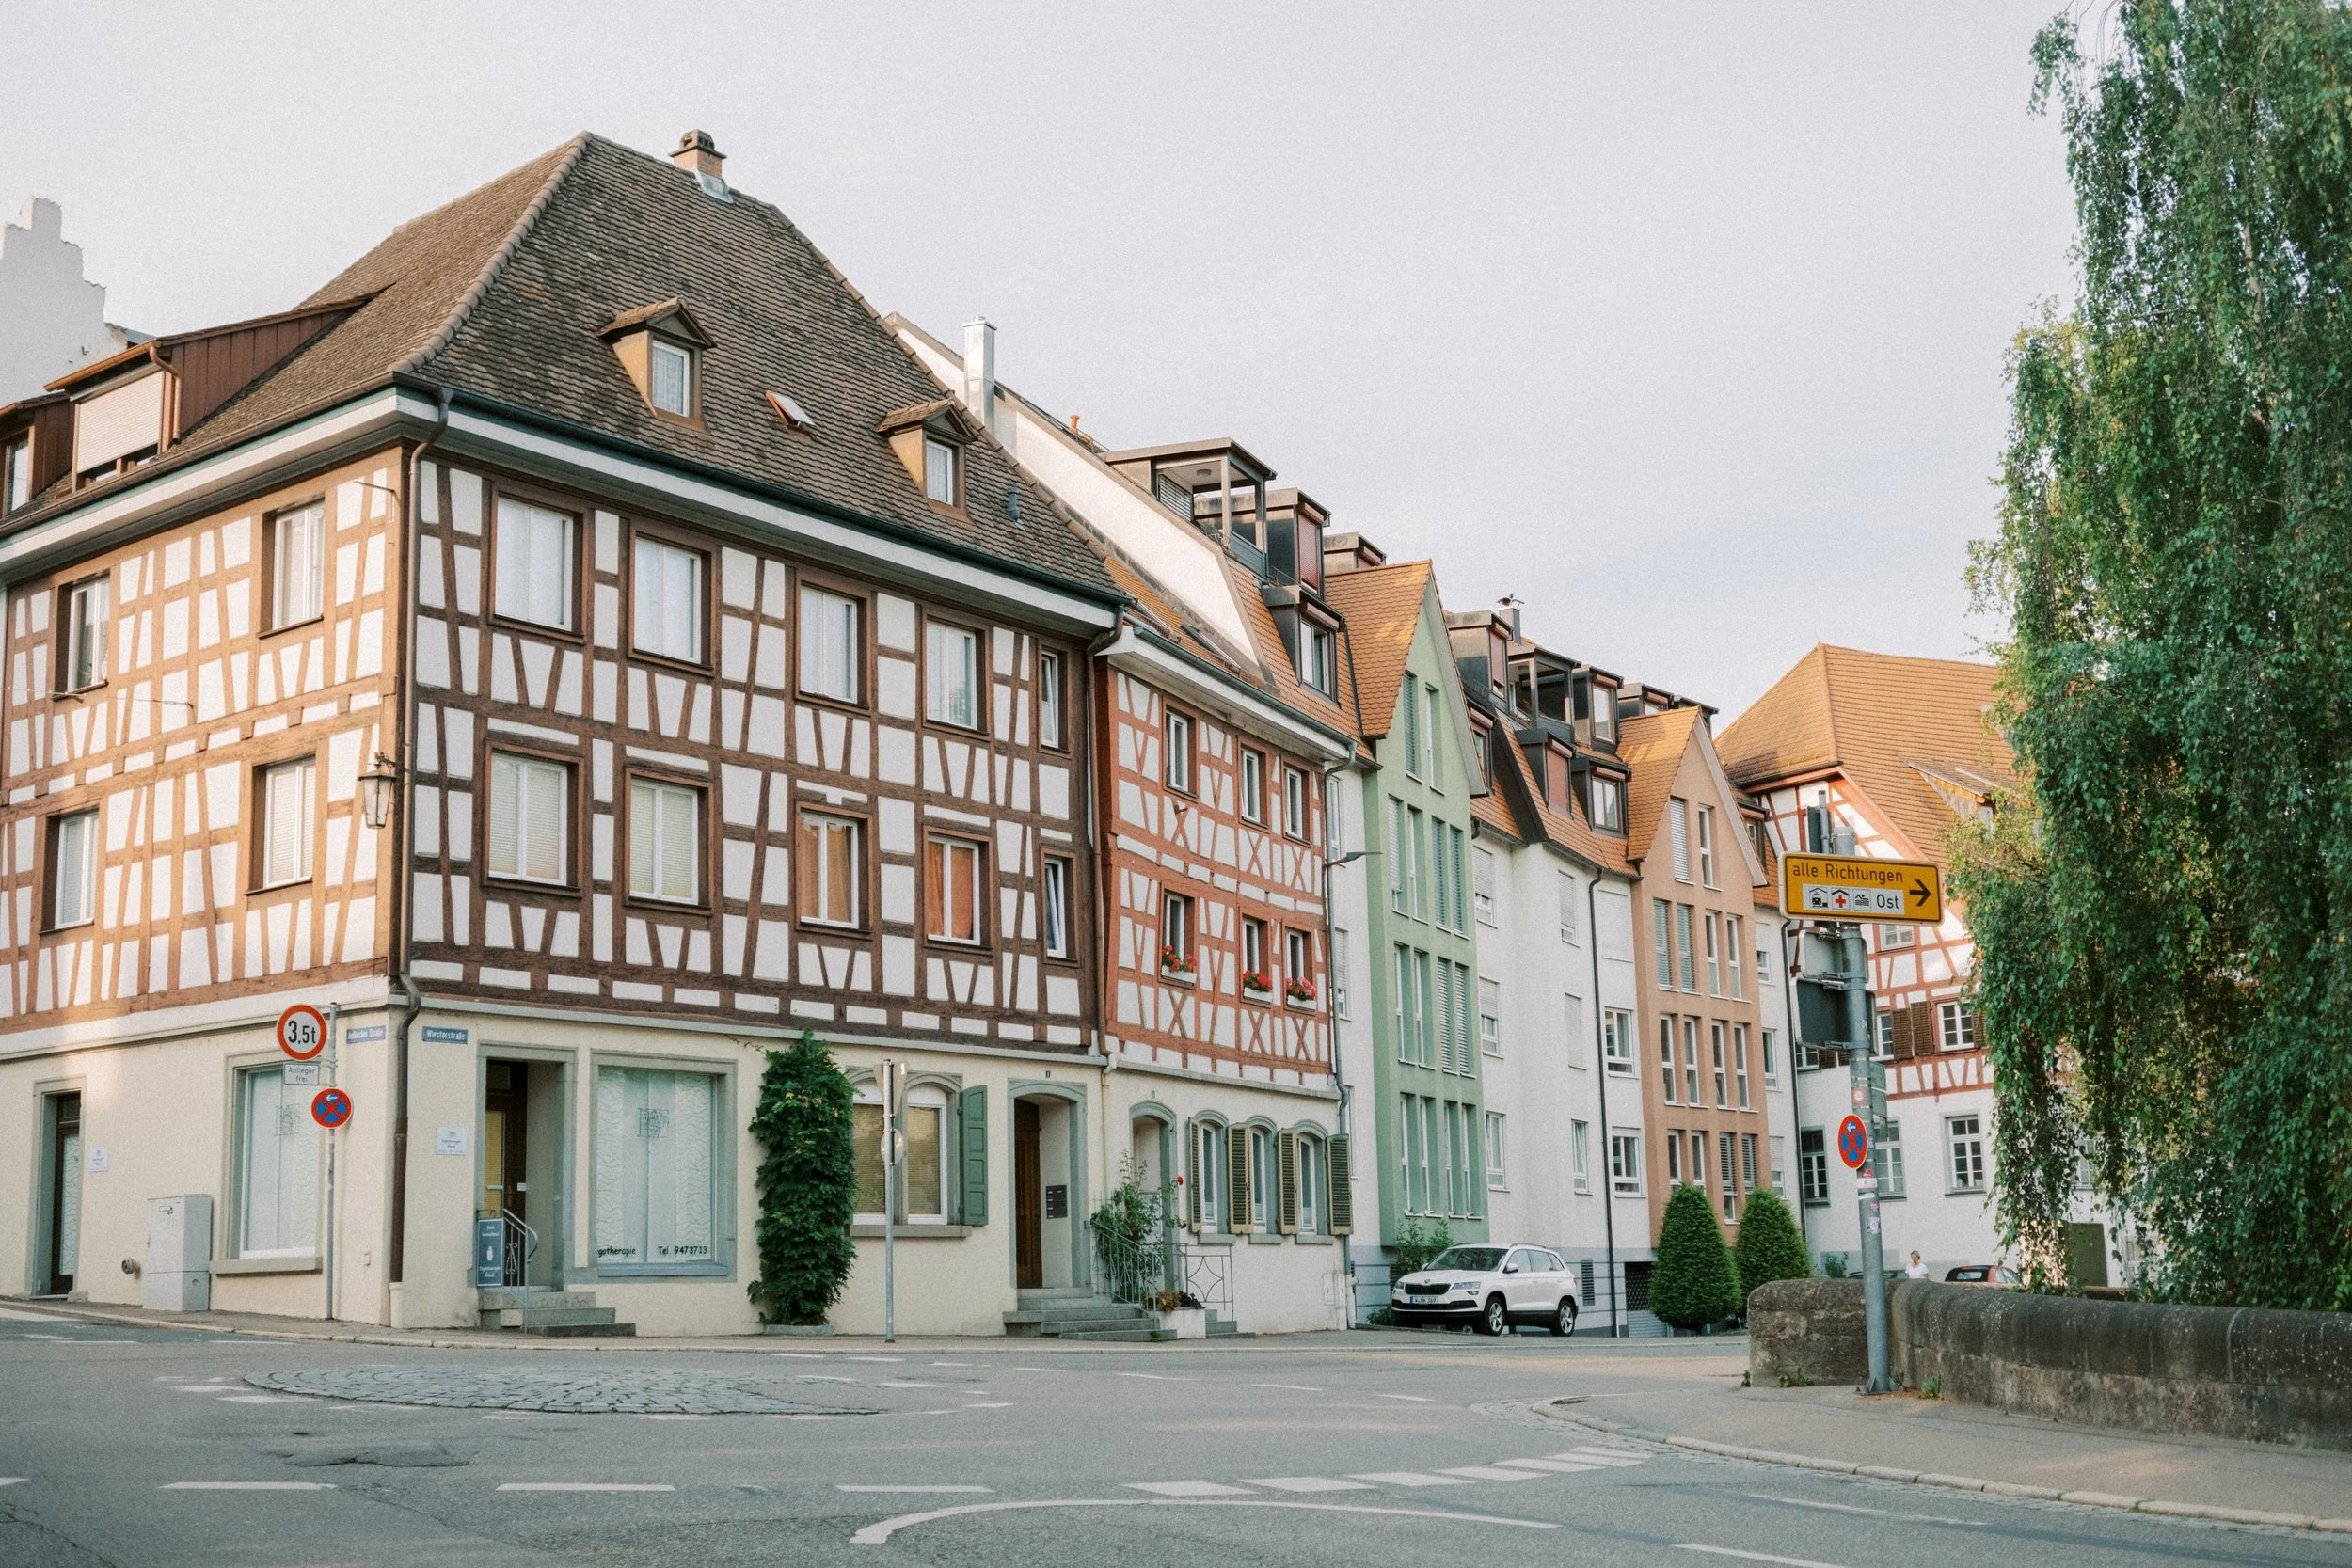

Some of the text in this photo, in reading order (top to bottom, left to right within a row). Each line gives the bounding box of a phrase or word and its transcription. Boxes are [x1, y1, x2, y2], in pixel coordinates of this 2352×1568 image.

[1792, 862, 1903, 885] alle Richtungen
[1876, 894, 1899, 910] Ost
[288, 1067, 315, 1075] Anlieger
[597, 1245, 636, 1258] gotherapie
[658, 1245, 672, 1255] Tel.
